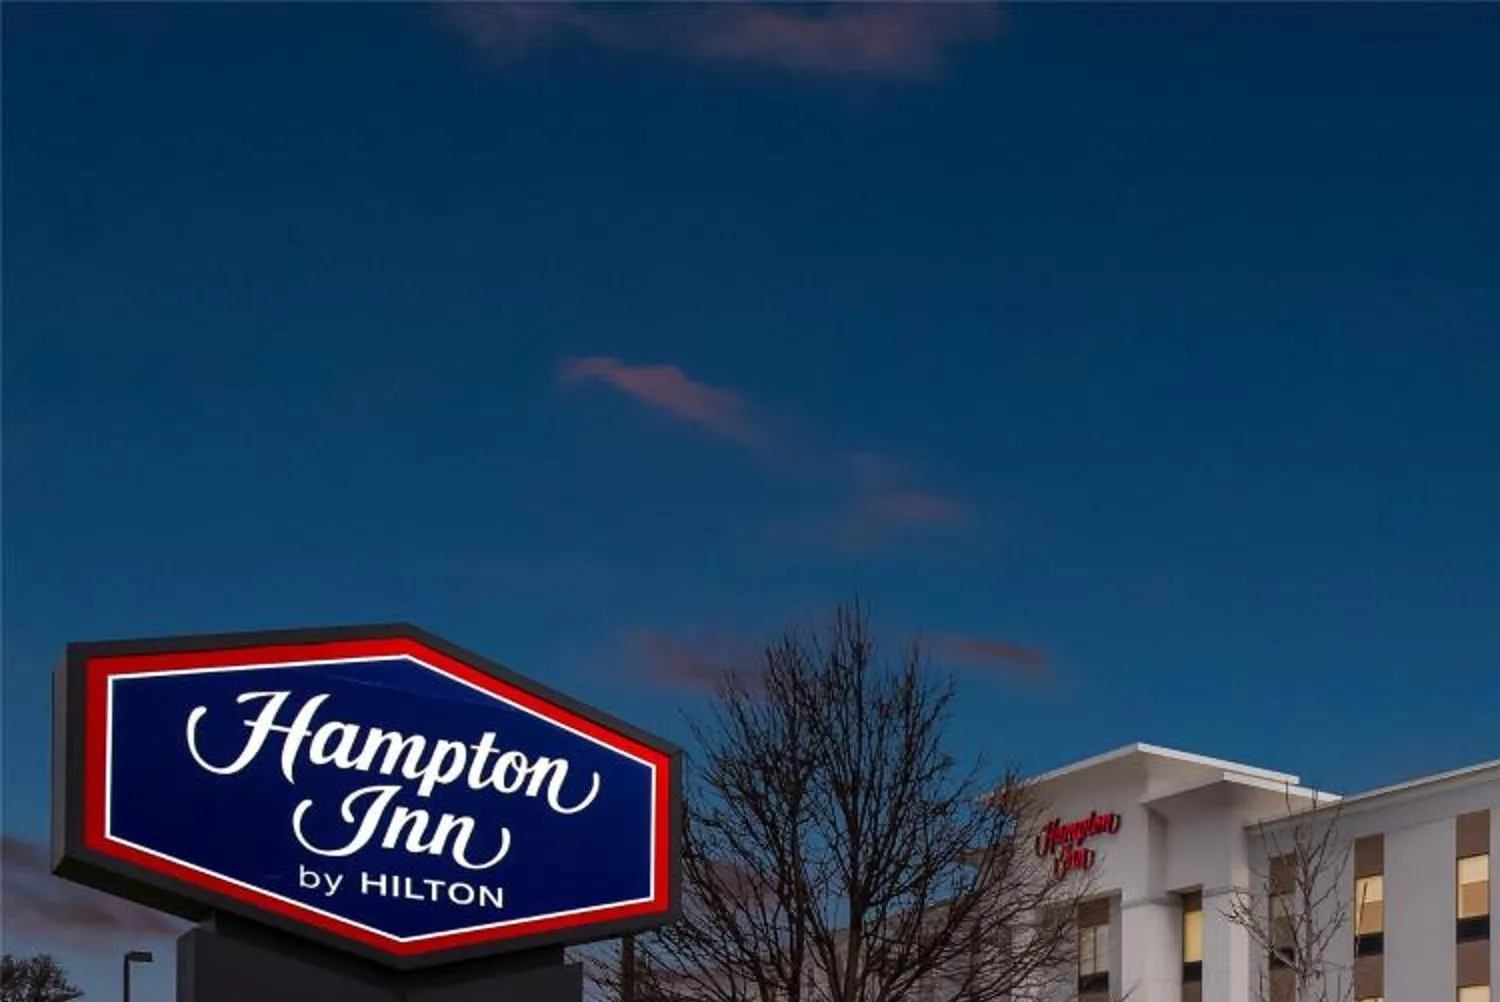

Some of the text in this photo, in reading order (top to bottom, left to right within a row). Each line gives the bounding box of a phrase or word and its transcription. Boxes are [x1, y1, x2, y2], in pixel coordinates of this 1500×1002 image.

[186, 690, 600, 814] Hampton
[292, 785, 511, 870] Inn
[299, 865, 503, 909] by HILTON
